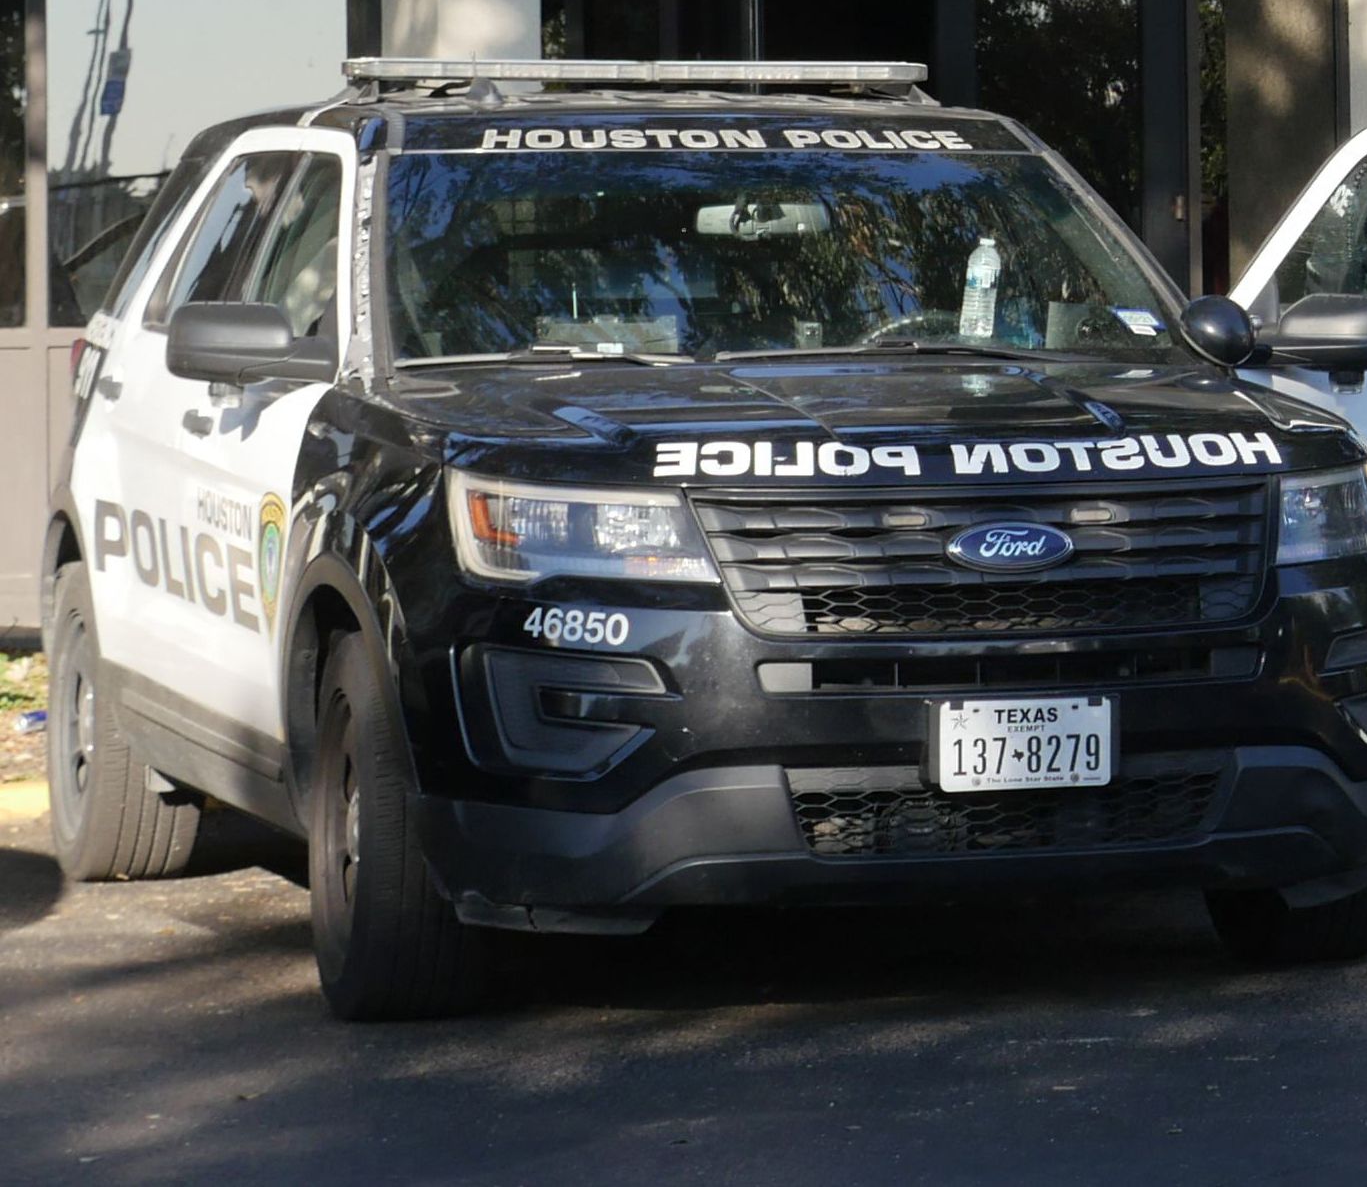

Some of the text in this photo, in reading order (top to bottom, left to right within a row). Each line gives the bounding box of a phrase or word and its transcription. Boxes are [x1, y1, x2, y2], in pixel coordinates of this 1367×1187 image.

[482, 128, 973, 150] HOUSTON POLICE
[979, 529, 1047, 557] Ford
[94, 498, 261, 634] POLICE
[523, 607, 630, 647] 46850
[994, 708, 1058, 724] TEXAS
[1007, 725, 1046, 733] EXEMPT
